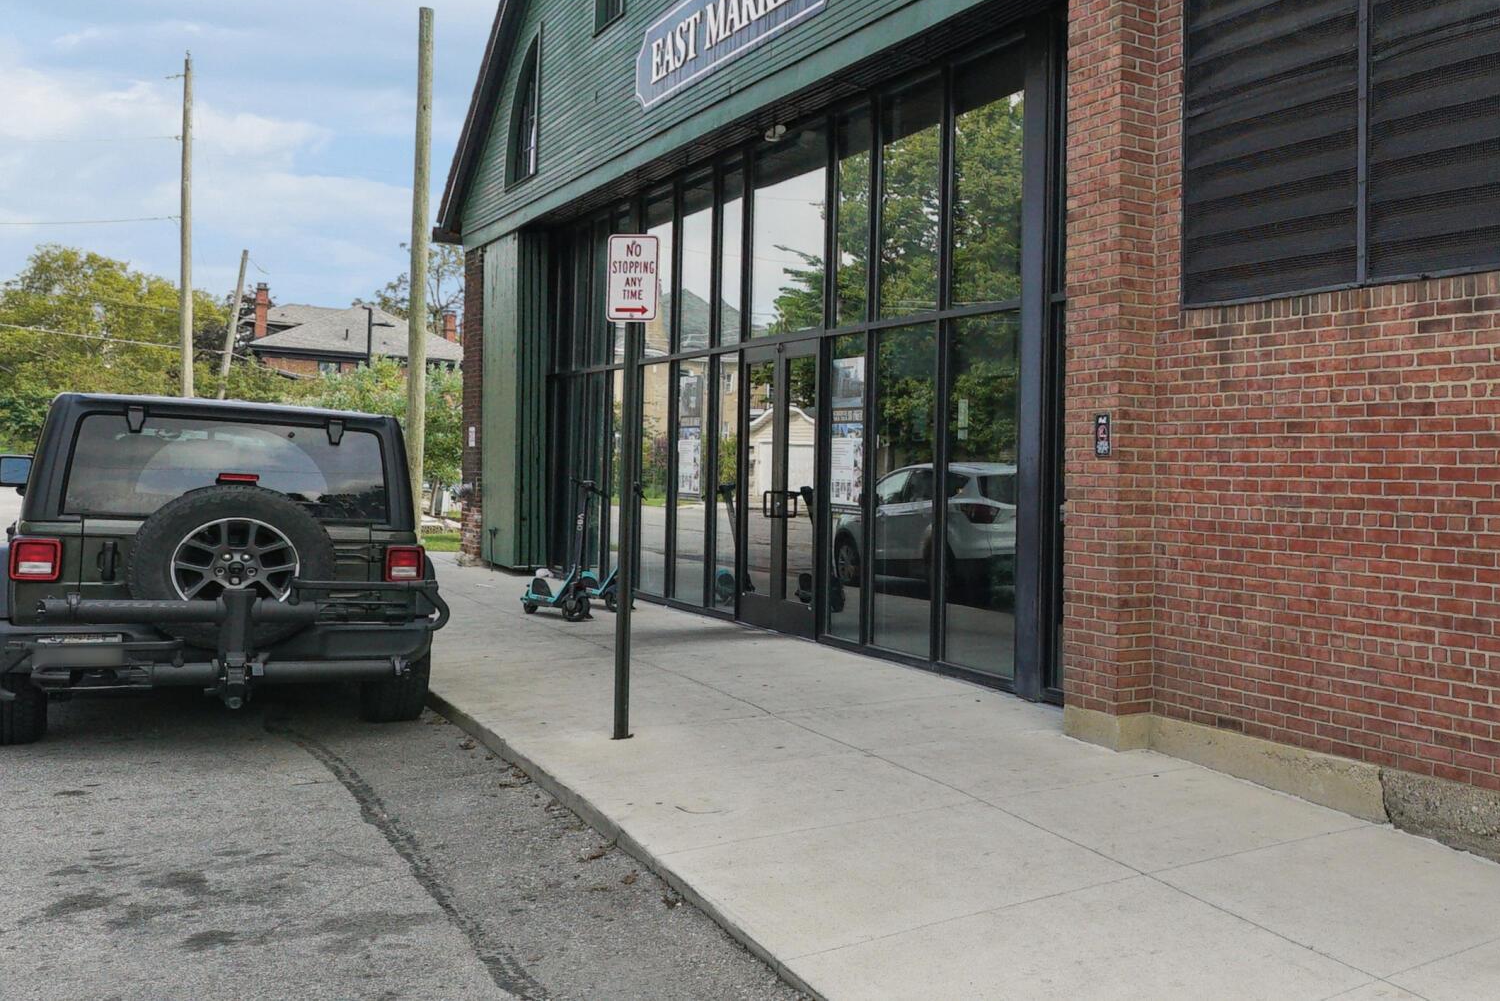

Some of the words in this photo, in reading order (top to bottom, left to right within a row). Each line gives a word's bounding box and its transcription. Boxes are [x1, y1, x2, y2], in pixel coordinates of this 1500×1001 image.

[651, 10, 702, 84] EAST
[626, 244, 642, 257] NO
[612, 260, 655, 274] STOPPING
[624, 277, 642, 287] ANY
[622, 289, 643, 300] TIME
